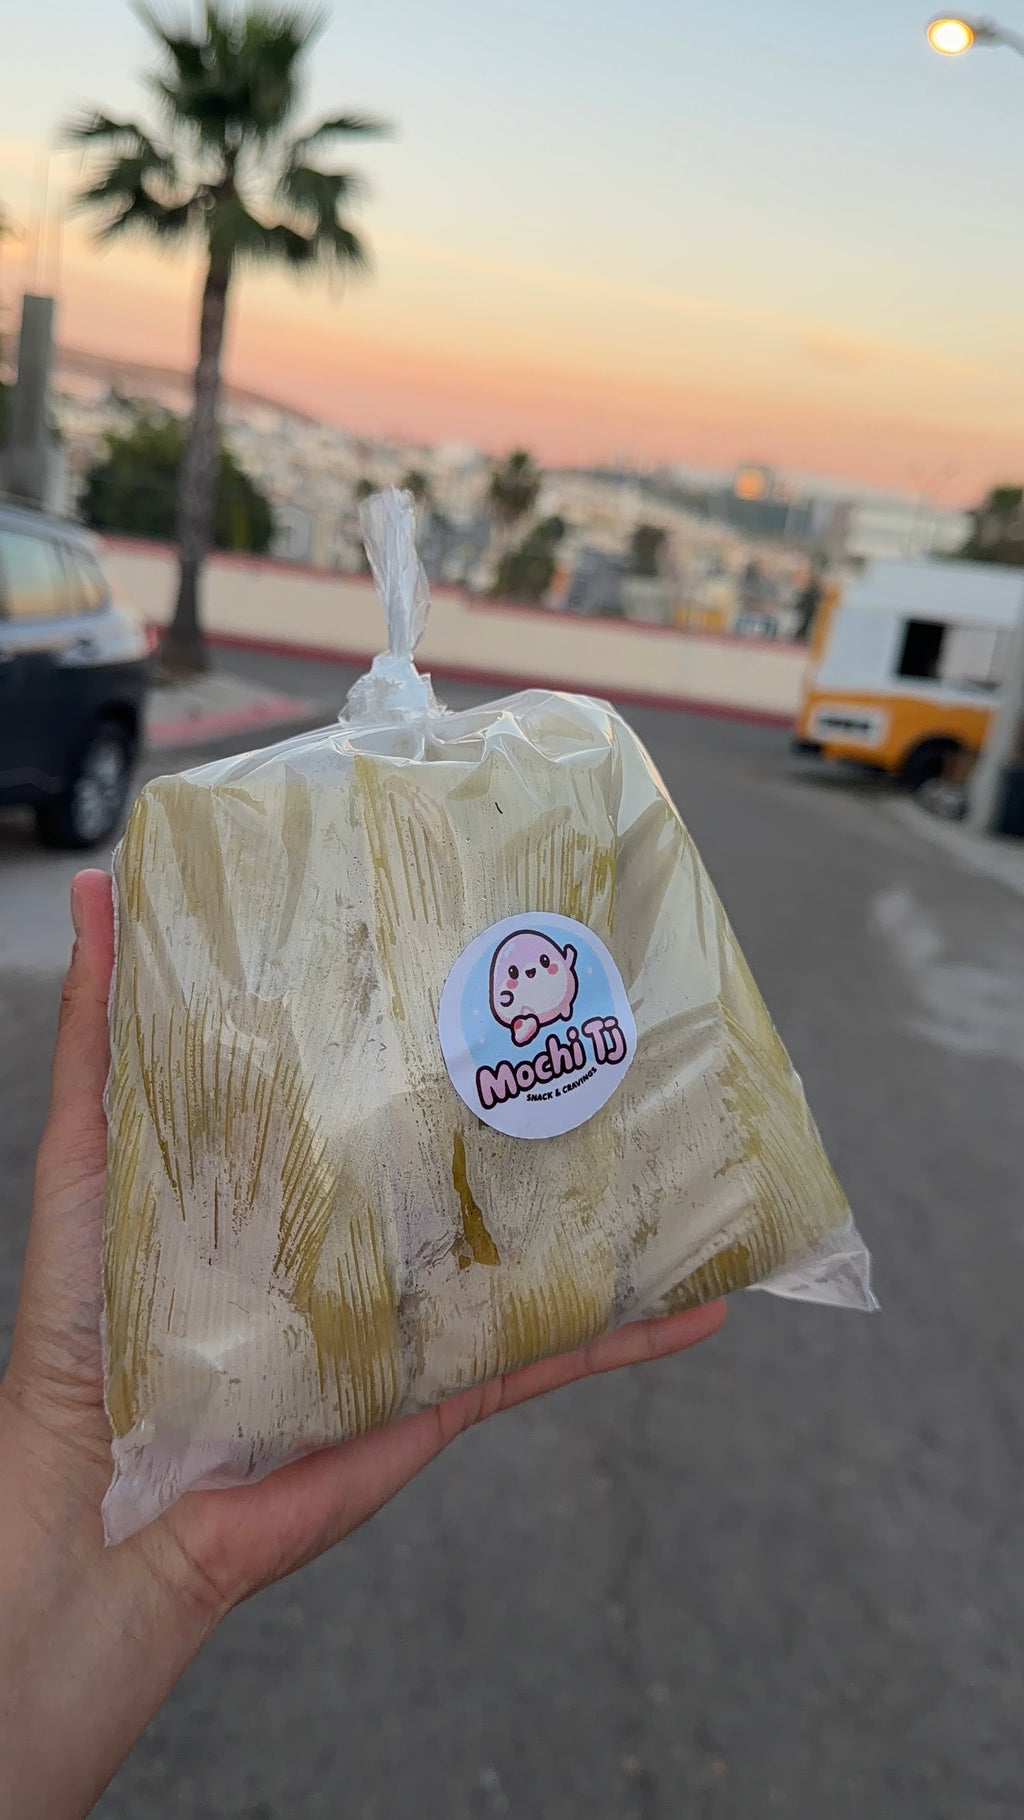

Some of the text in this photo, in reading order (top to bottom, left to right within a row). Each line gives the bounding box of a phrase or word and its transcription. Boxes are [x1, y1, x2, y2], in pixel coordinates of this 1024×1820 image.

[476, 1026, 586, 1109] Mochi
[526, 1066, 597, 1102] SNACK & CRAVINGS
